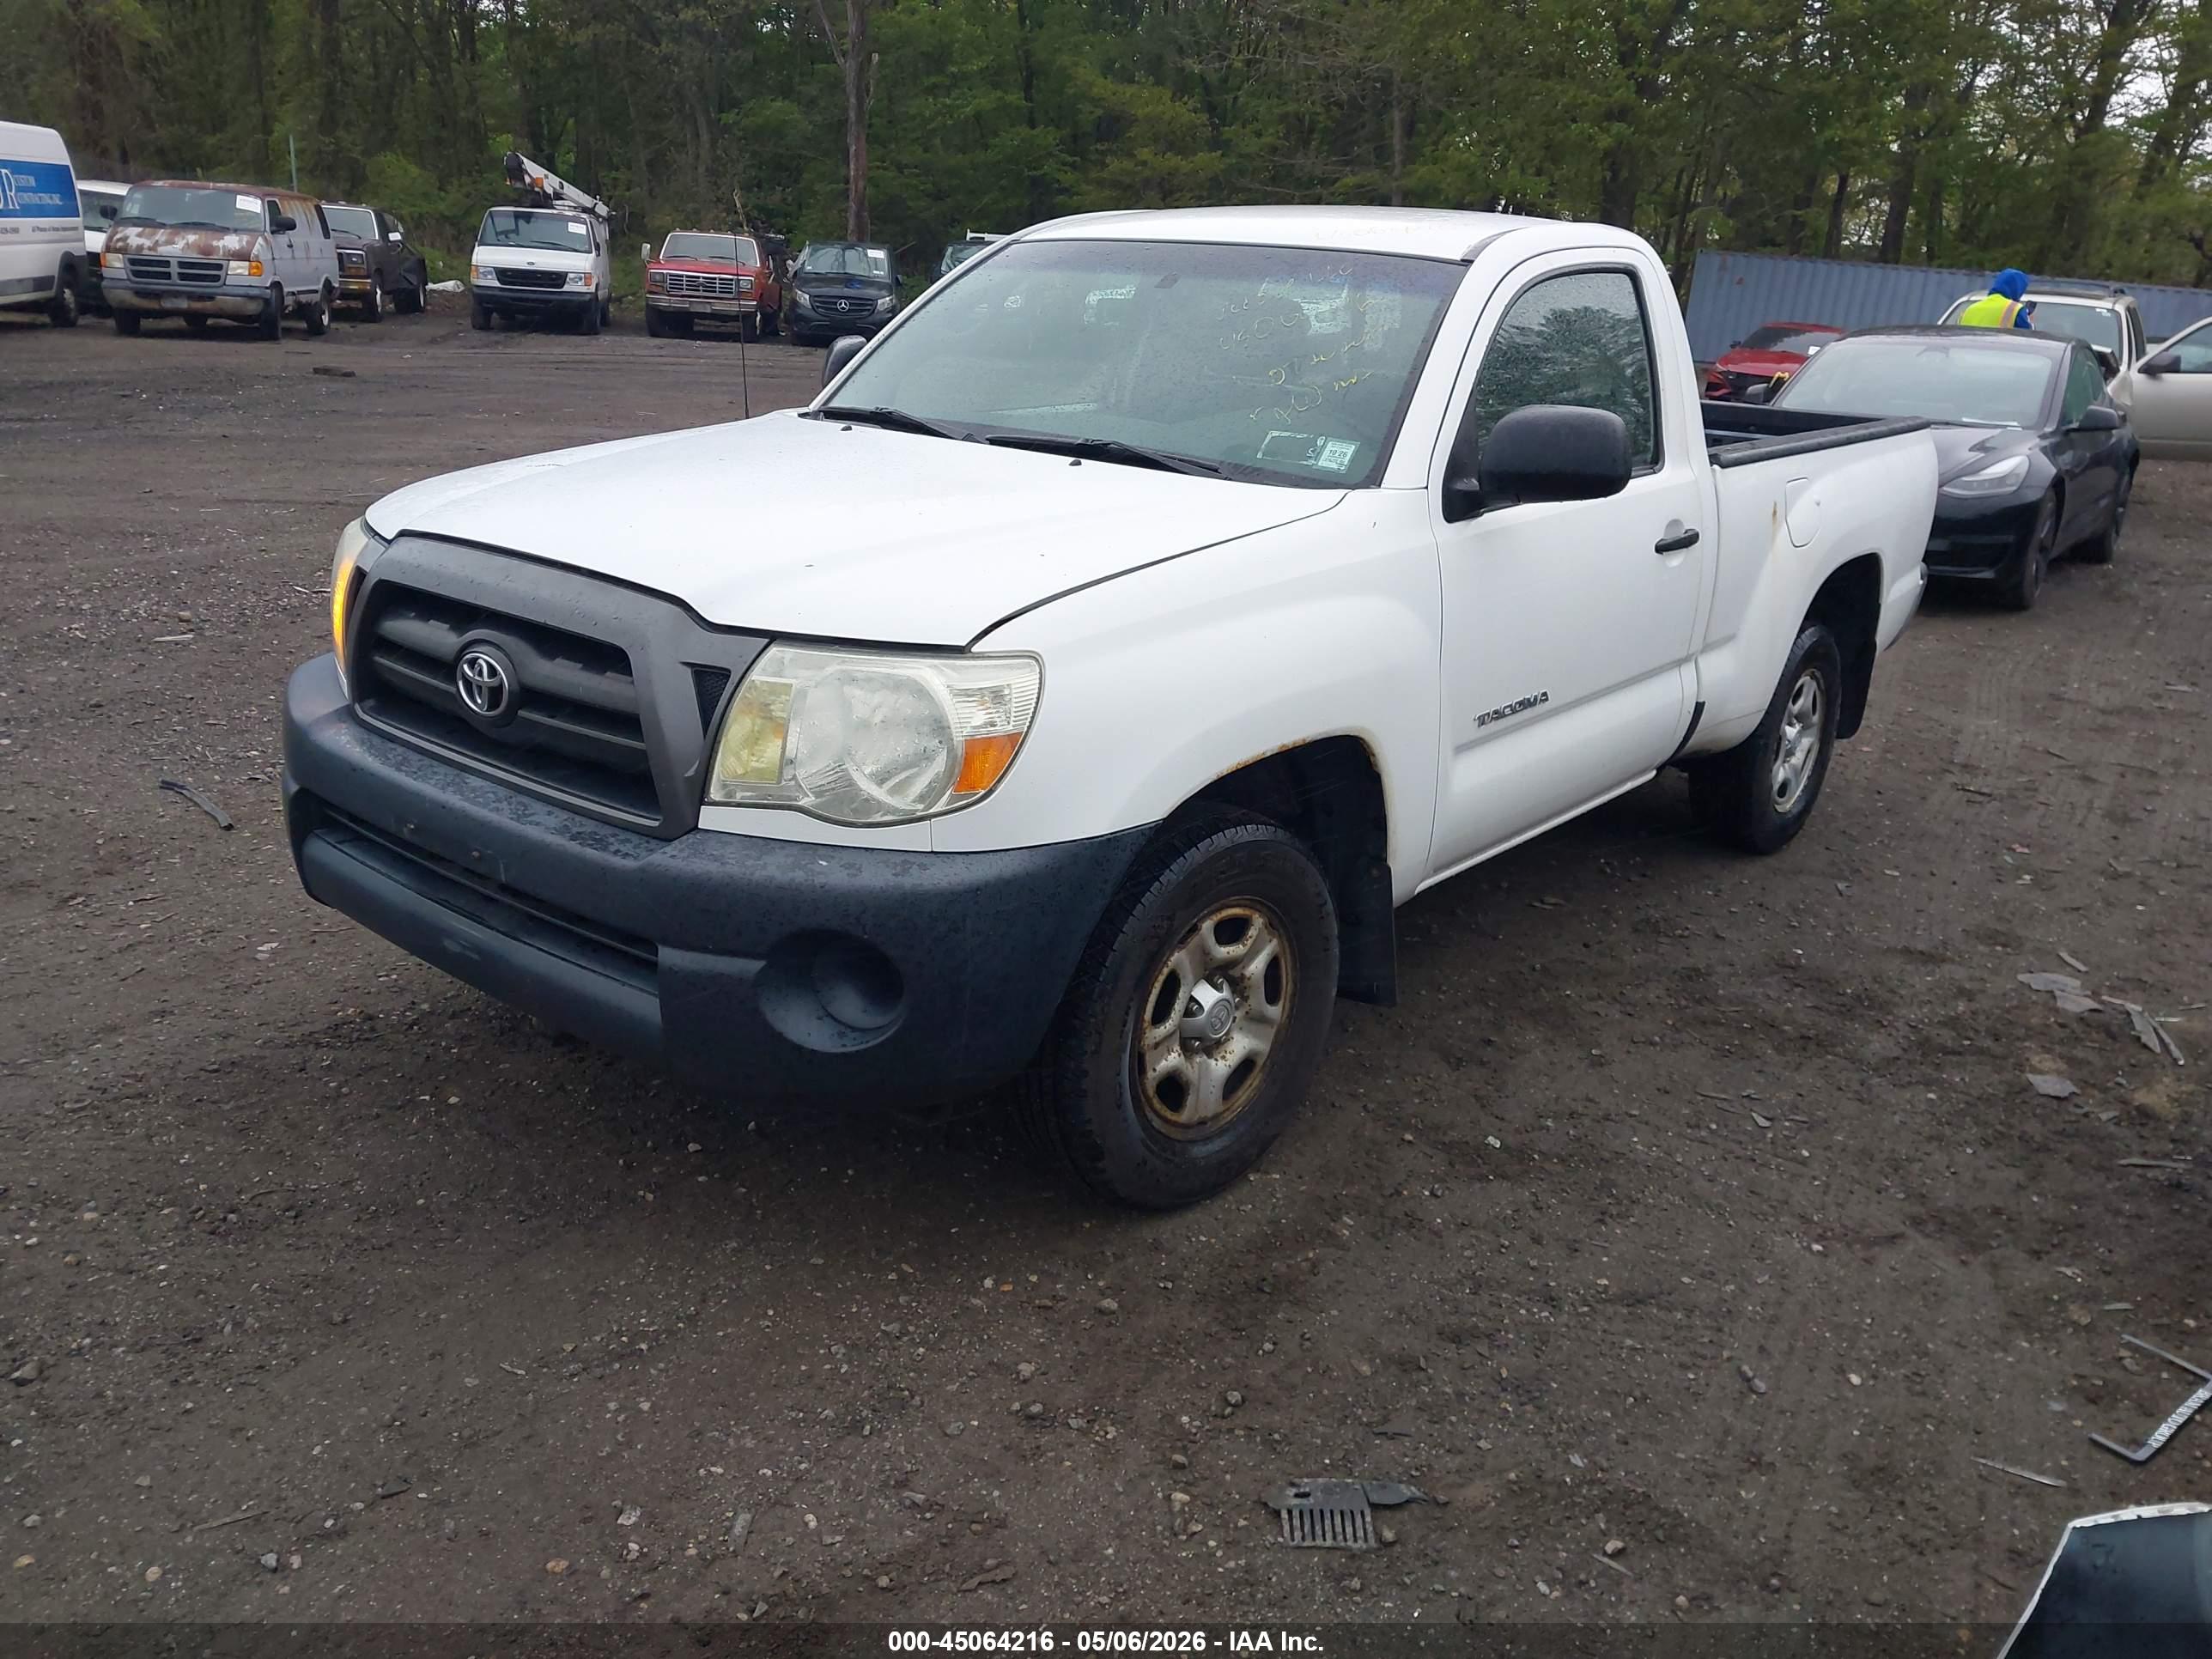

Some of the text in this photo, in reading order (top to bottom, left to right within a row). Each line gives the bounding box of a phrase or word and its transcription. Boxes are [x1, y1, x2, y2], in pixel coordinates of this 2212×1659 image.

[1474, 690, 1549, 727] TACOMA
[2166, 1405, 2196, 1427] AUTO
[2146, 1421, 2179, 1449] GROUP
